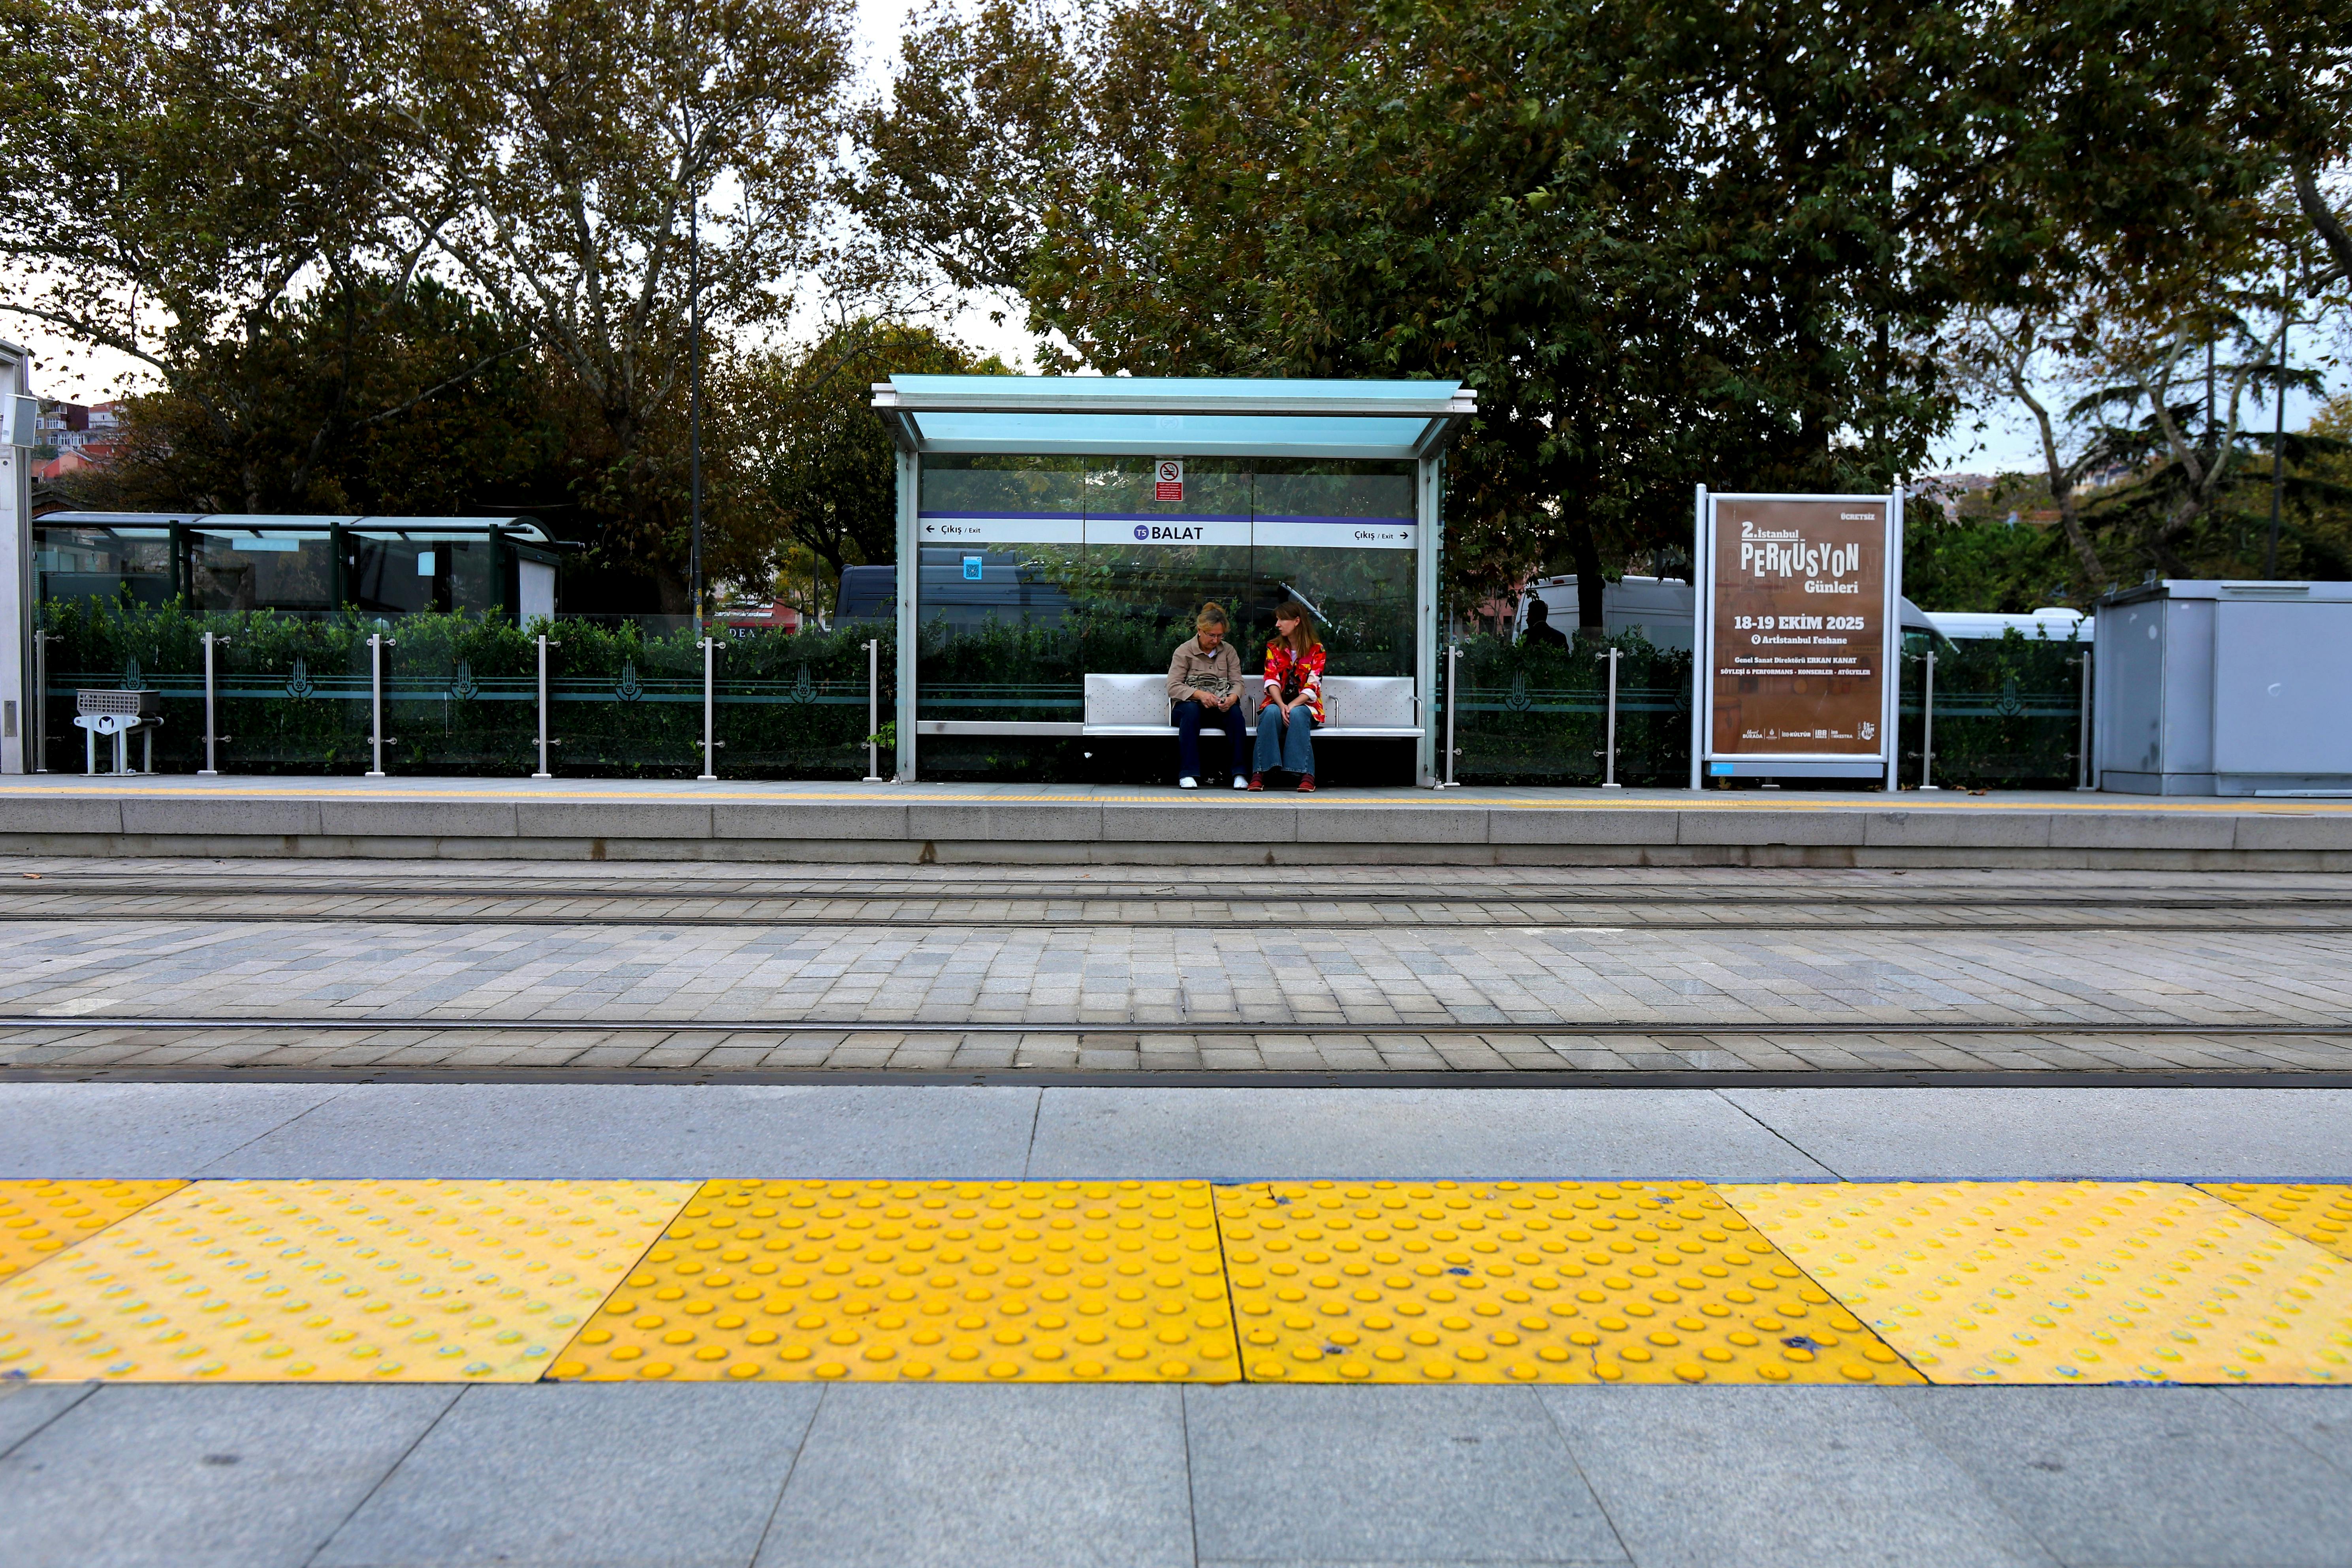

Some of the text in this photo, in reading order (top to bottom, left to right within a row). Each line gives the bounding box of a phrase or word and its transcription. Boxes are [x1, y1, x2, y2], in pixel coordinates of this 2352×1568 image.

[941, 525, 962, 535] Çıkış
[1152, 527, 1203, 539] BALAT
[1355, 531, 1375, 540] Çıkış
[1741, 538, 1859, 577] PERKÜSYON
[1804, 580, 1858, 593] Günleri
[1734, 614, 1864, 630] 18-19 EKİM 2025
[1762, 634, 1847, 645] Artİstanbul Feshane
